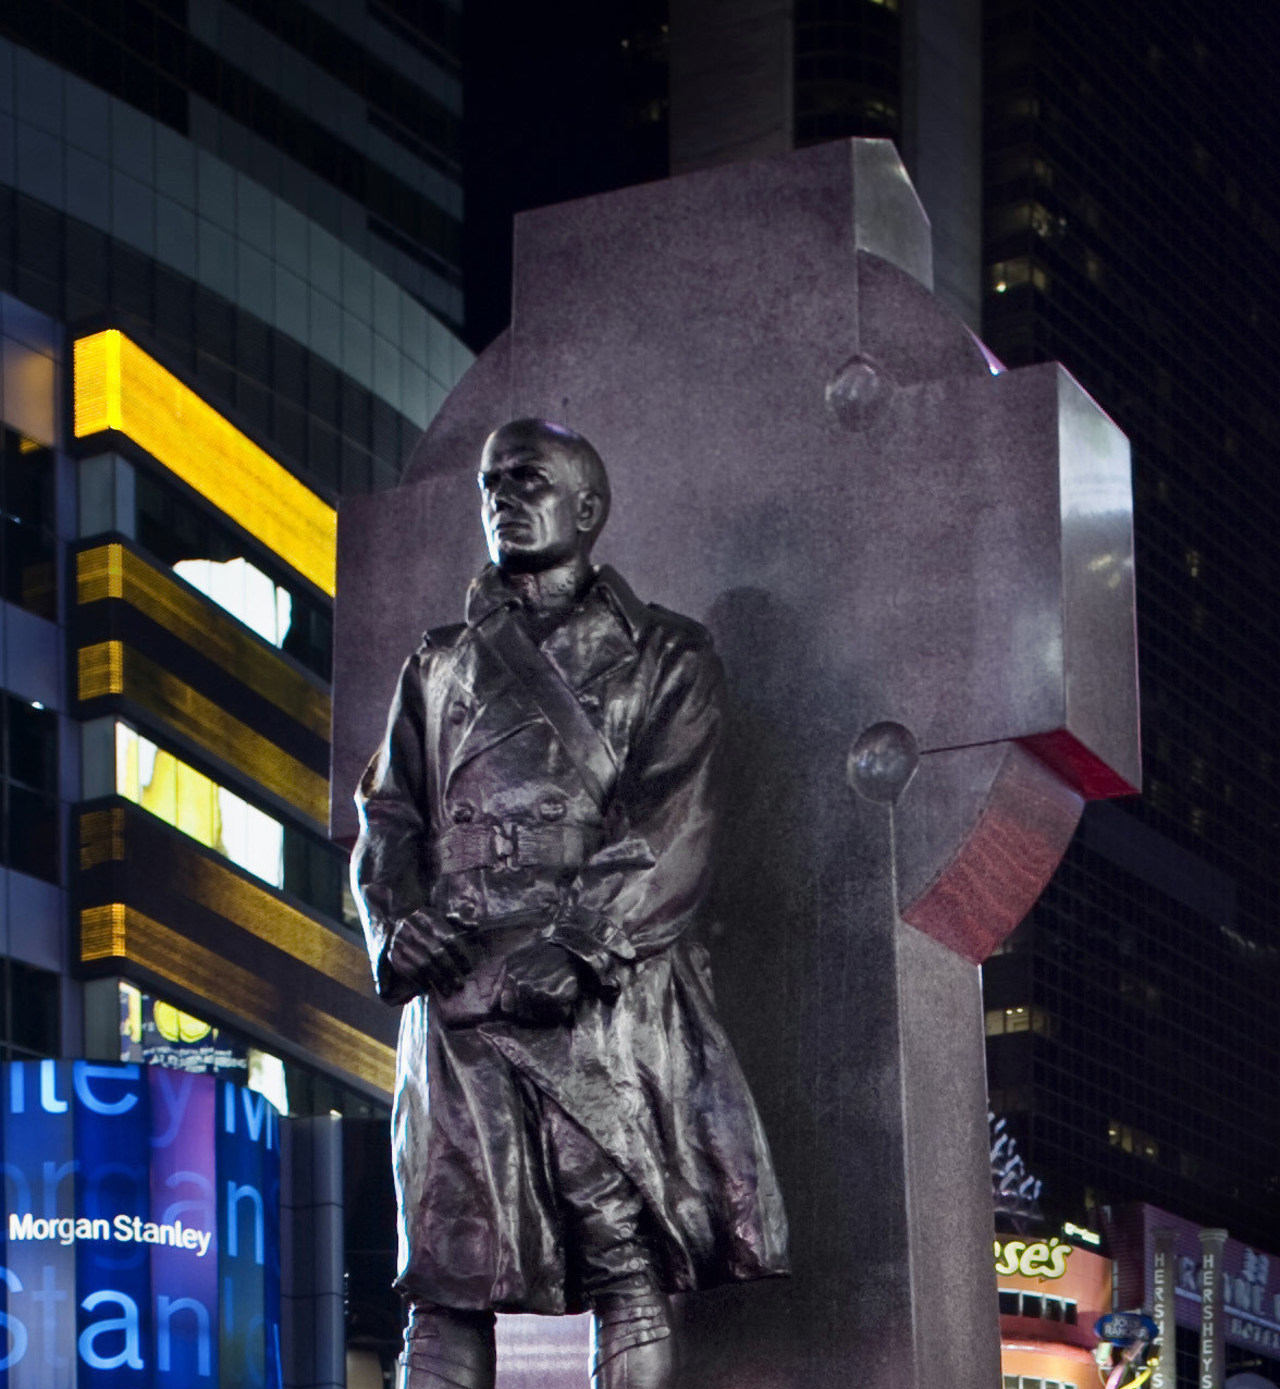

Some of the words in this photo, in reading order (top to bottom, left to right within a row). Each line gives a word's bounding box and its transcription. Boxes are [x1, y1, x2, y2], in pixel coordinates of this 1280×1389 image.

[9, 1213, 110, 1246] Morgan
[113, 1214, 212, 1257] Stanley
[994, 1237, 1072, 1278] se's
[1202, 1254, 1215, 1389] HERSHEYS
